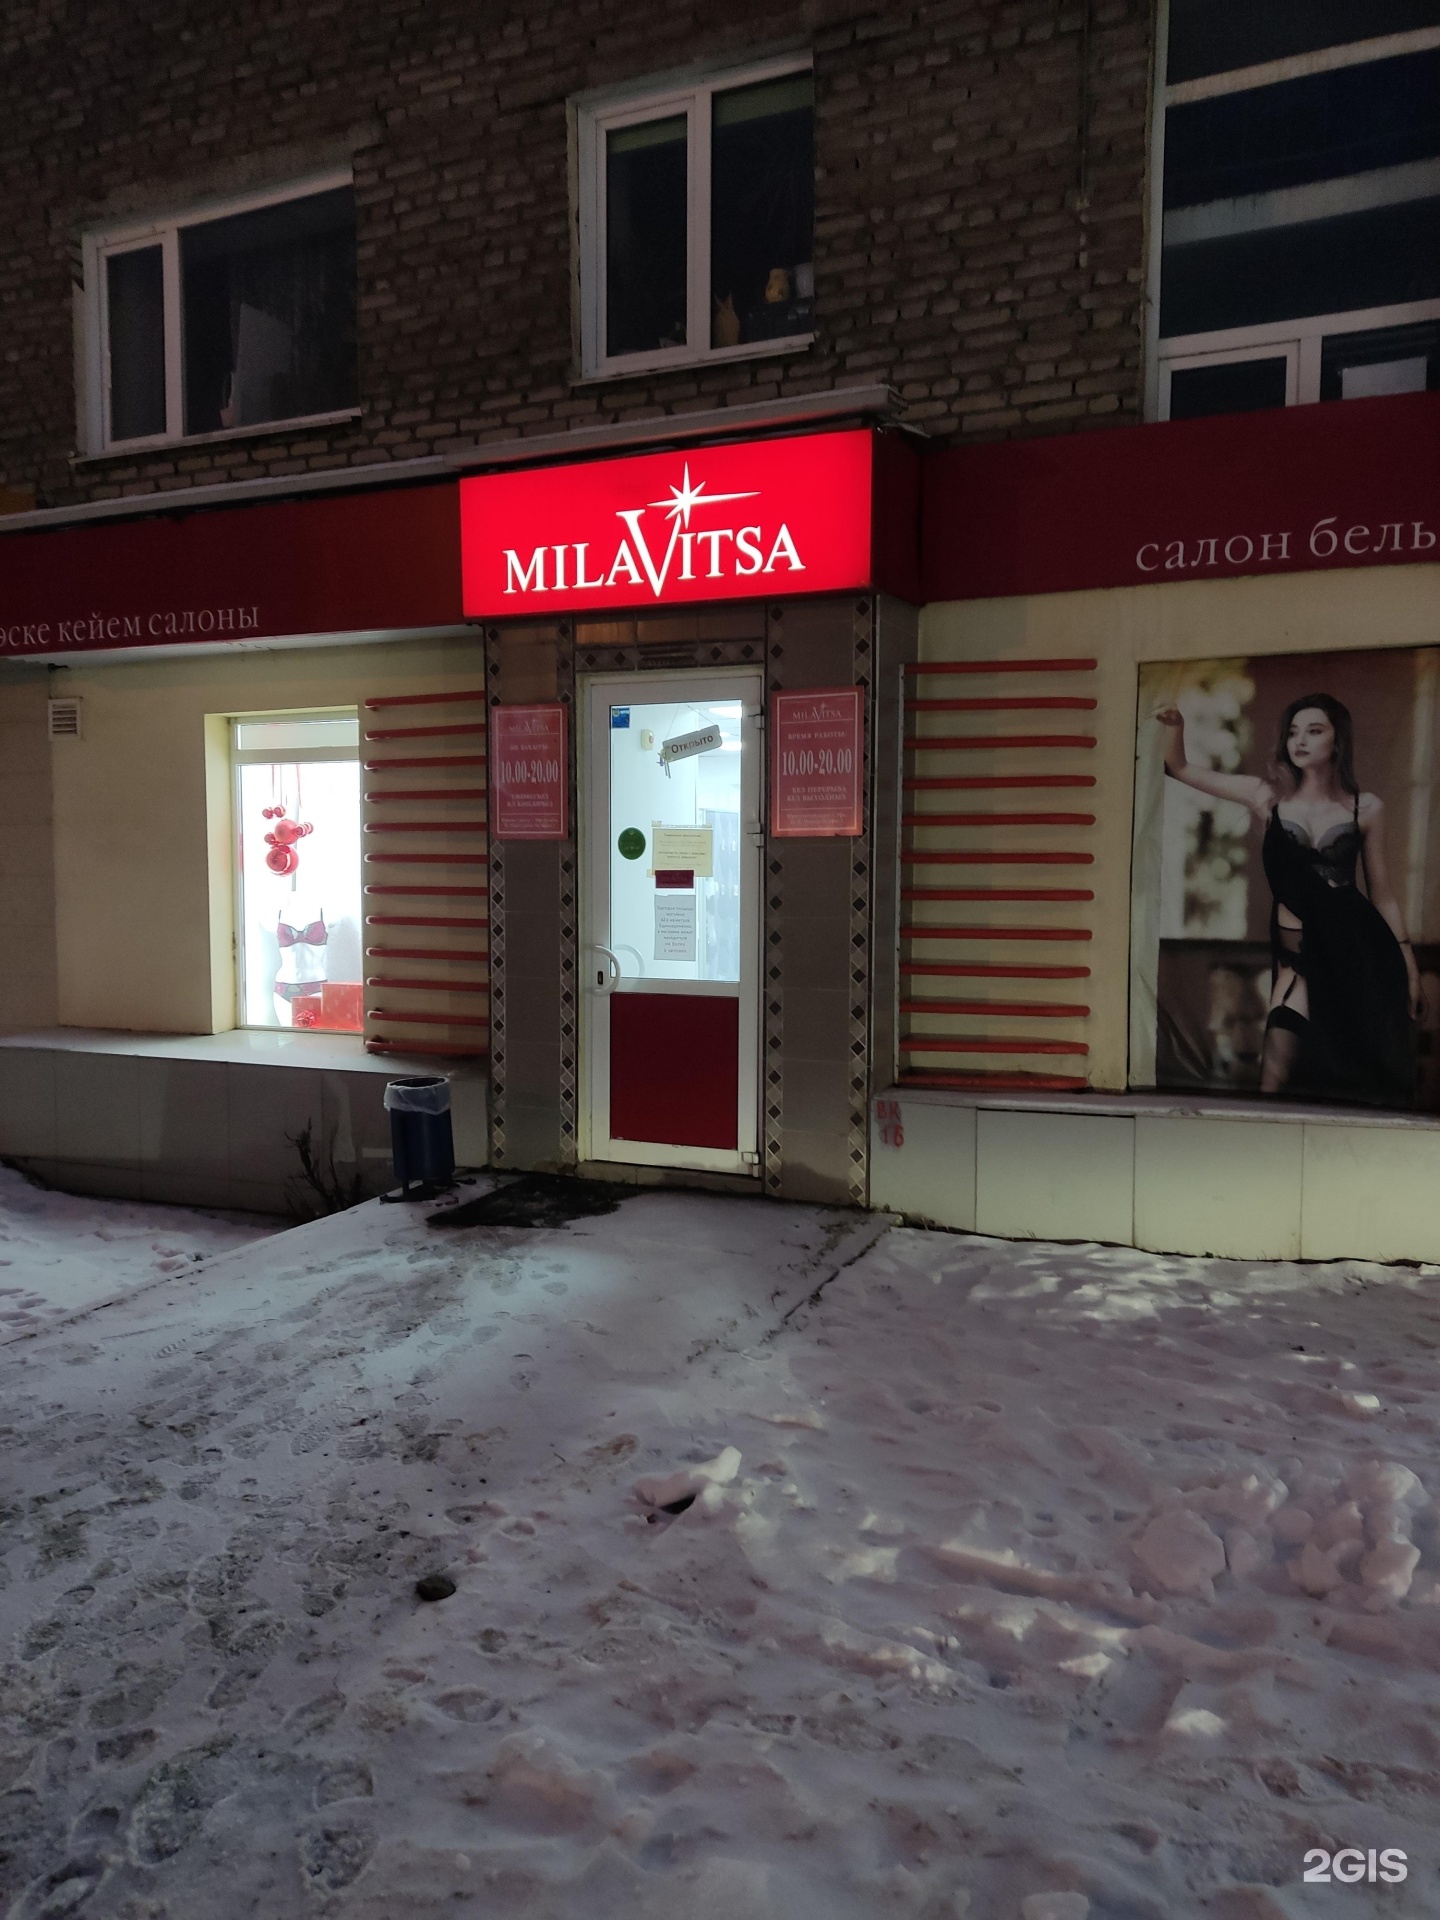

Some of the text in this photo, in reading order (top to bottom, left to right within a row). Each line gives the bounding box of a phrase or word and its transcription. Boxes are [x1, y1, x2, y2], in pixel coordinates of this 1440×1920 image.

[503, 509, 806, 597] MILAVITSA
[1136, 516, 1437, 571] салон бель
[57, 611, 141, 642] кейем
[148, 606, 259, 635] салоны
[501, 760, 558, 784] 10.00-20.00
[782, 748, 852, 776] 10.00-20.00
